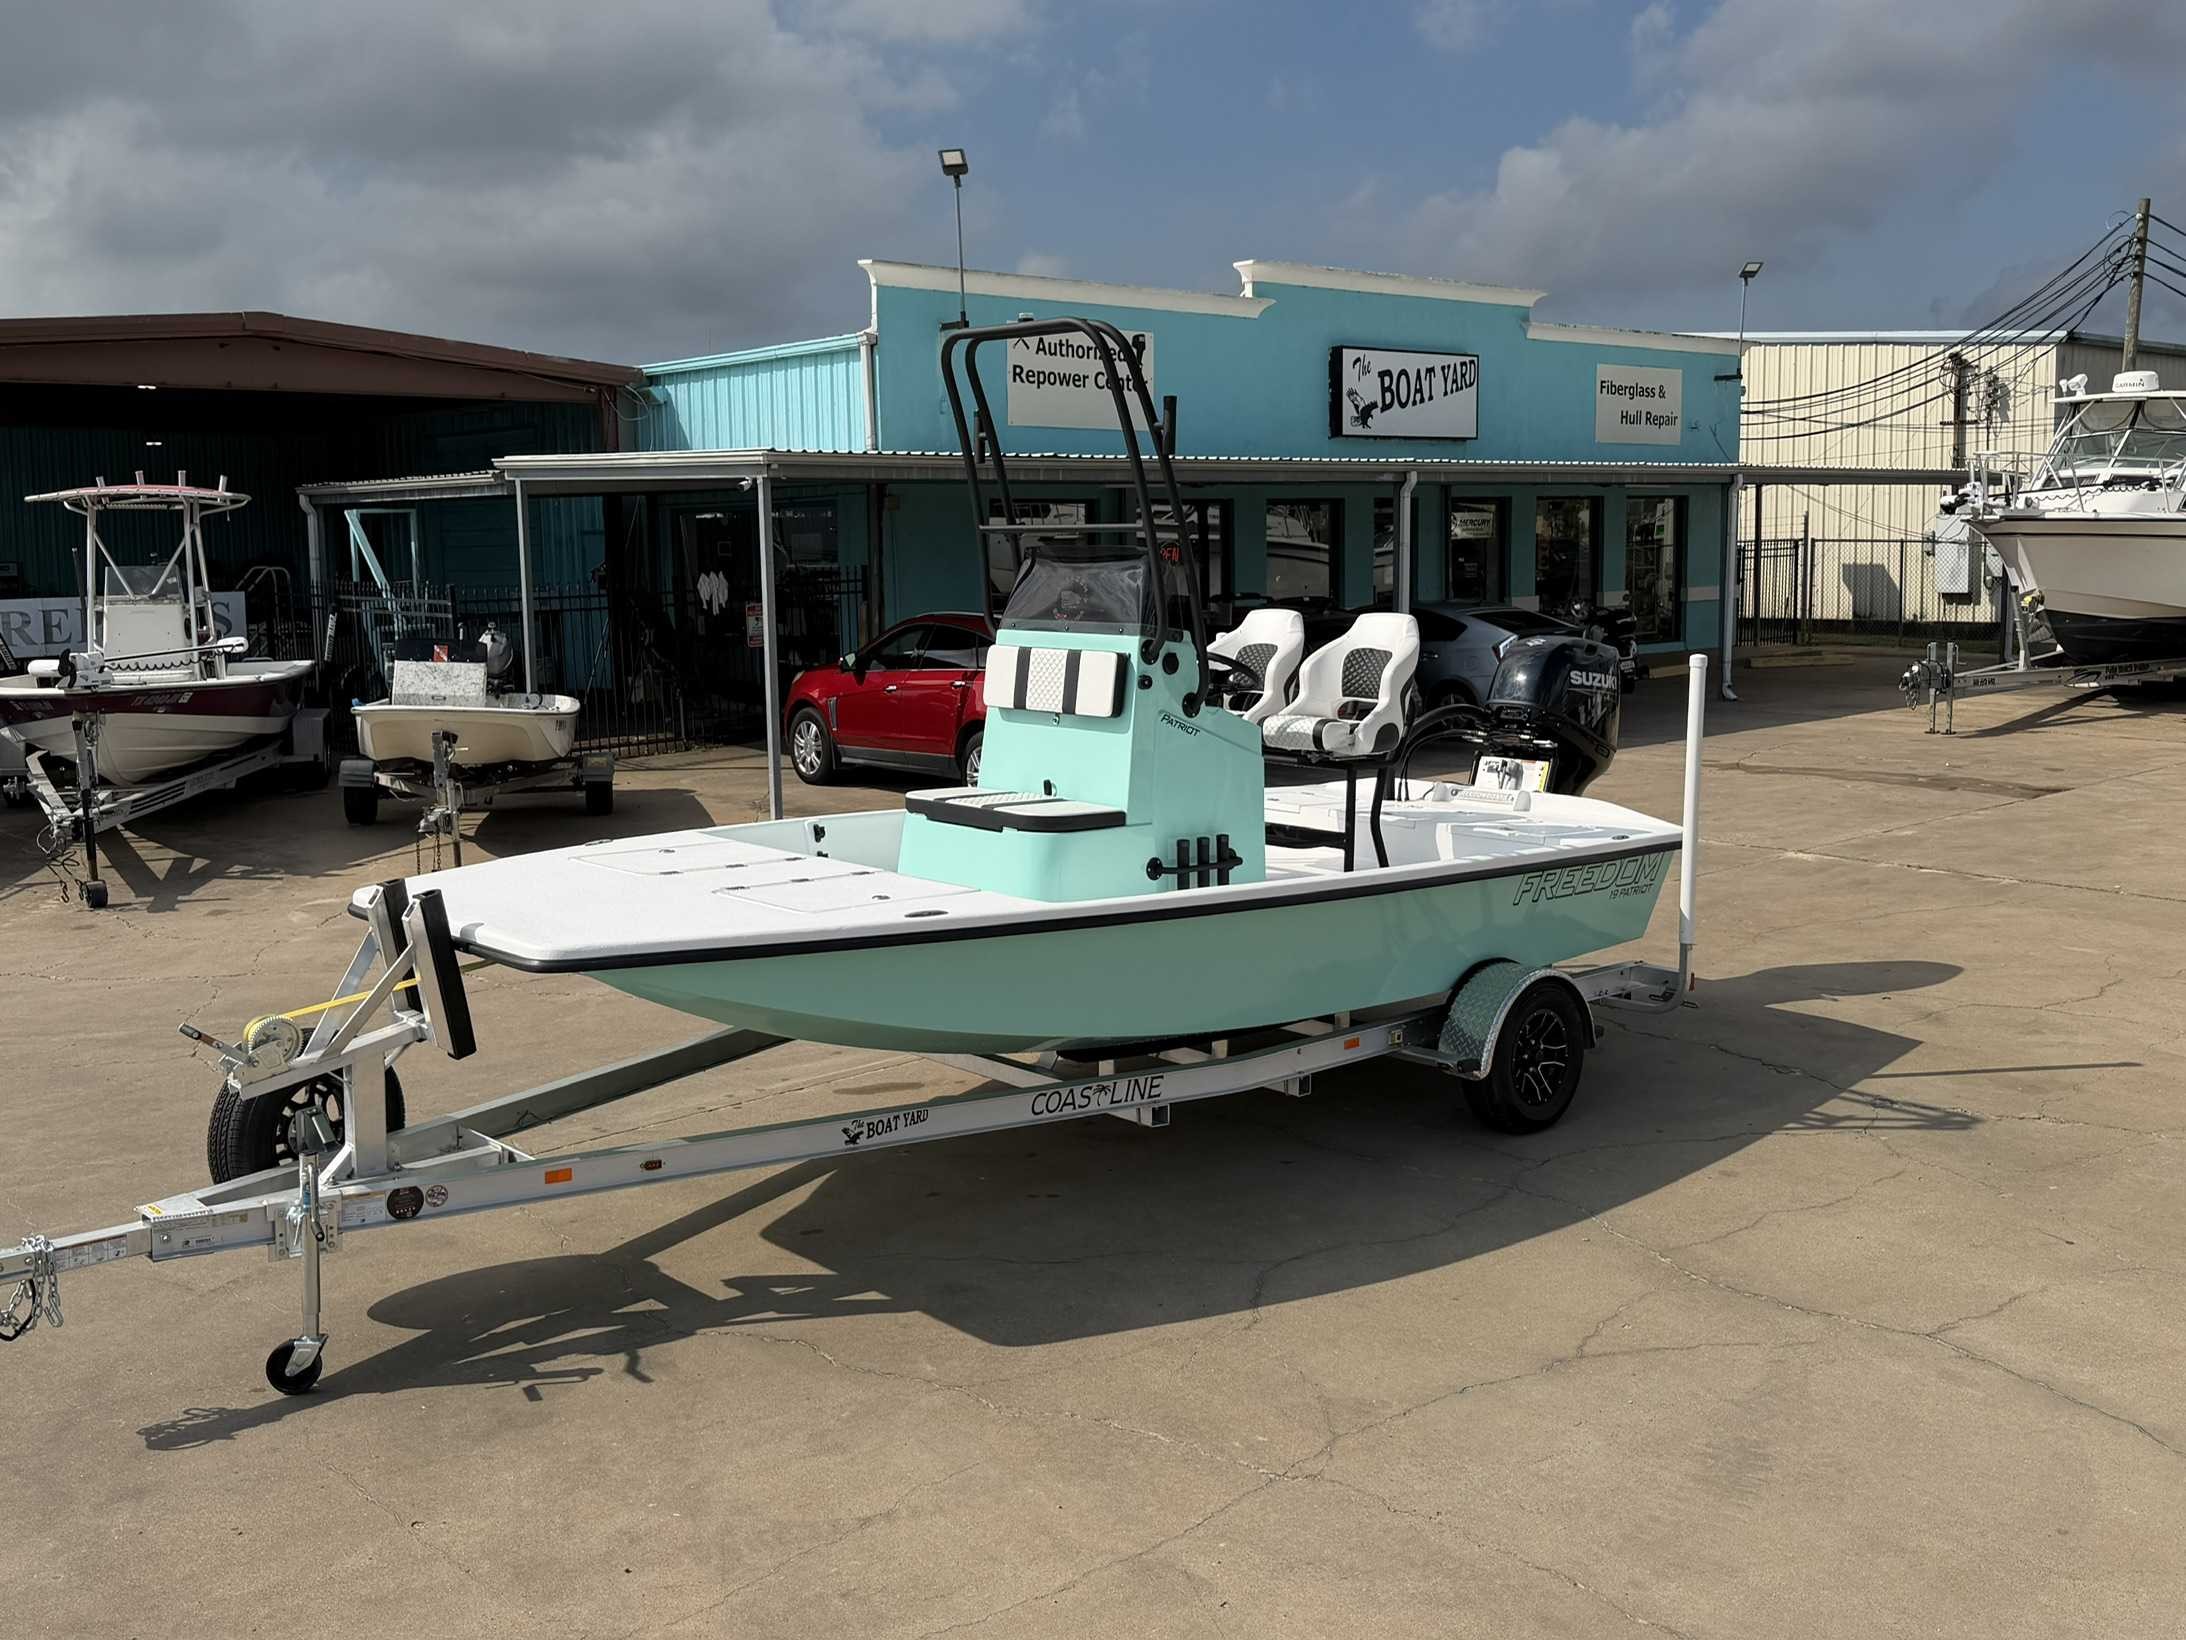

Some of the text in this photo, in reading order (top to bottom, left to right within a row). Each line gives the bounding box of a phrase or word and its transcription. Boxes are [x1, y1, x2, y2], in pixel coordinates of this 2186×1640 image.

[1035, 337, 1128, 362] Authoried
[1012, 364, 1148, 392] Repower Cnt
[1352, 353, 1372, 382] The
[1378, 359, 1477, 413] BOAT YARD
[1600, 380, 1666, 400] Fiberglass &
[1620, 410, 1678, 429] Hull Repair
[1569, 670, 1617, 689] SUZUKI
[1160, 714, 1201, 737] PATRIOT
[1513, 852, 1664, 906] FREEDOM
[851, 1119, 864, 1131] The
[866, 1109, 929, 1139] BOAT YARD
